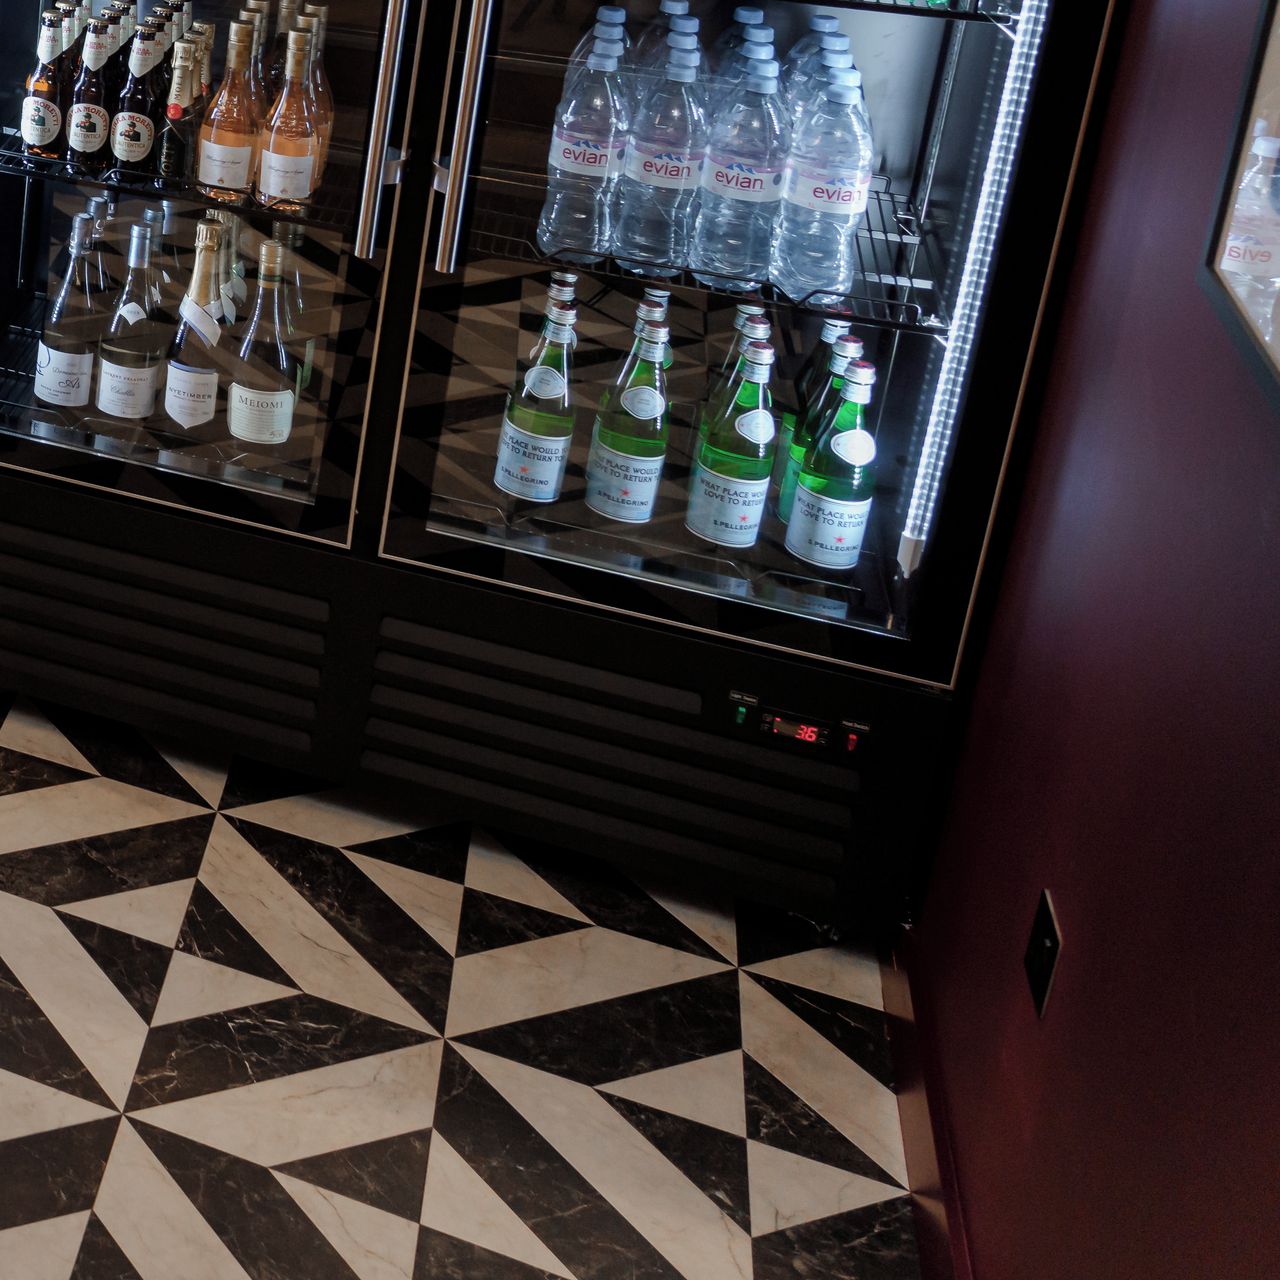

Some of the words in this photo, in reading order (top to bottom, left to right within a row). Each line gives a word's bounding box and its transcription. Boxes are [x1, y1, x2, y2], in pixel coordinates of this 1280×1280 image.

[127, 114, 153, 141] MORETTI
[562, 147, 609, 165] evian
[643, 160, 691, 177] evian
[715, 170, 764, 190] evian
[813, 186, 862, 202] evian
[168, 386, 213, 400] NYETIMBER
[239, 395, 283, 409] MEIOMI
[508, 435, 529, 449] PLACE
[531, 444, 560, 456] WOULD
[521, 450, 552, 462] RETURN
[605, 459, 631, 473] PLACE
[703, 489, 726, 503] LOVE
[727, 496, 740, 505] TO
[741, 498, 763, 507] RETUR
[723, 487, 749, 499] PLACE
[816, 507, 845, 520] PLACE
[713, 519, 758, 531] S.PELLEGRIN
[822, 516, 835, 526] TO
